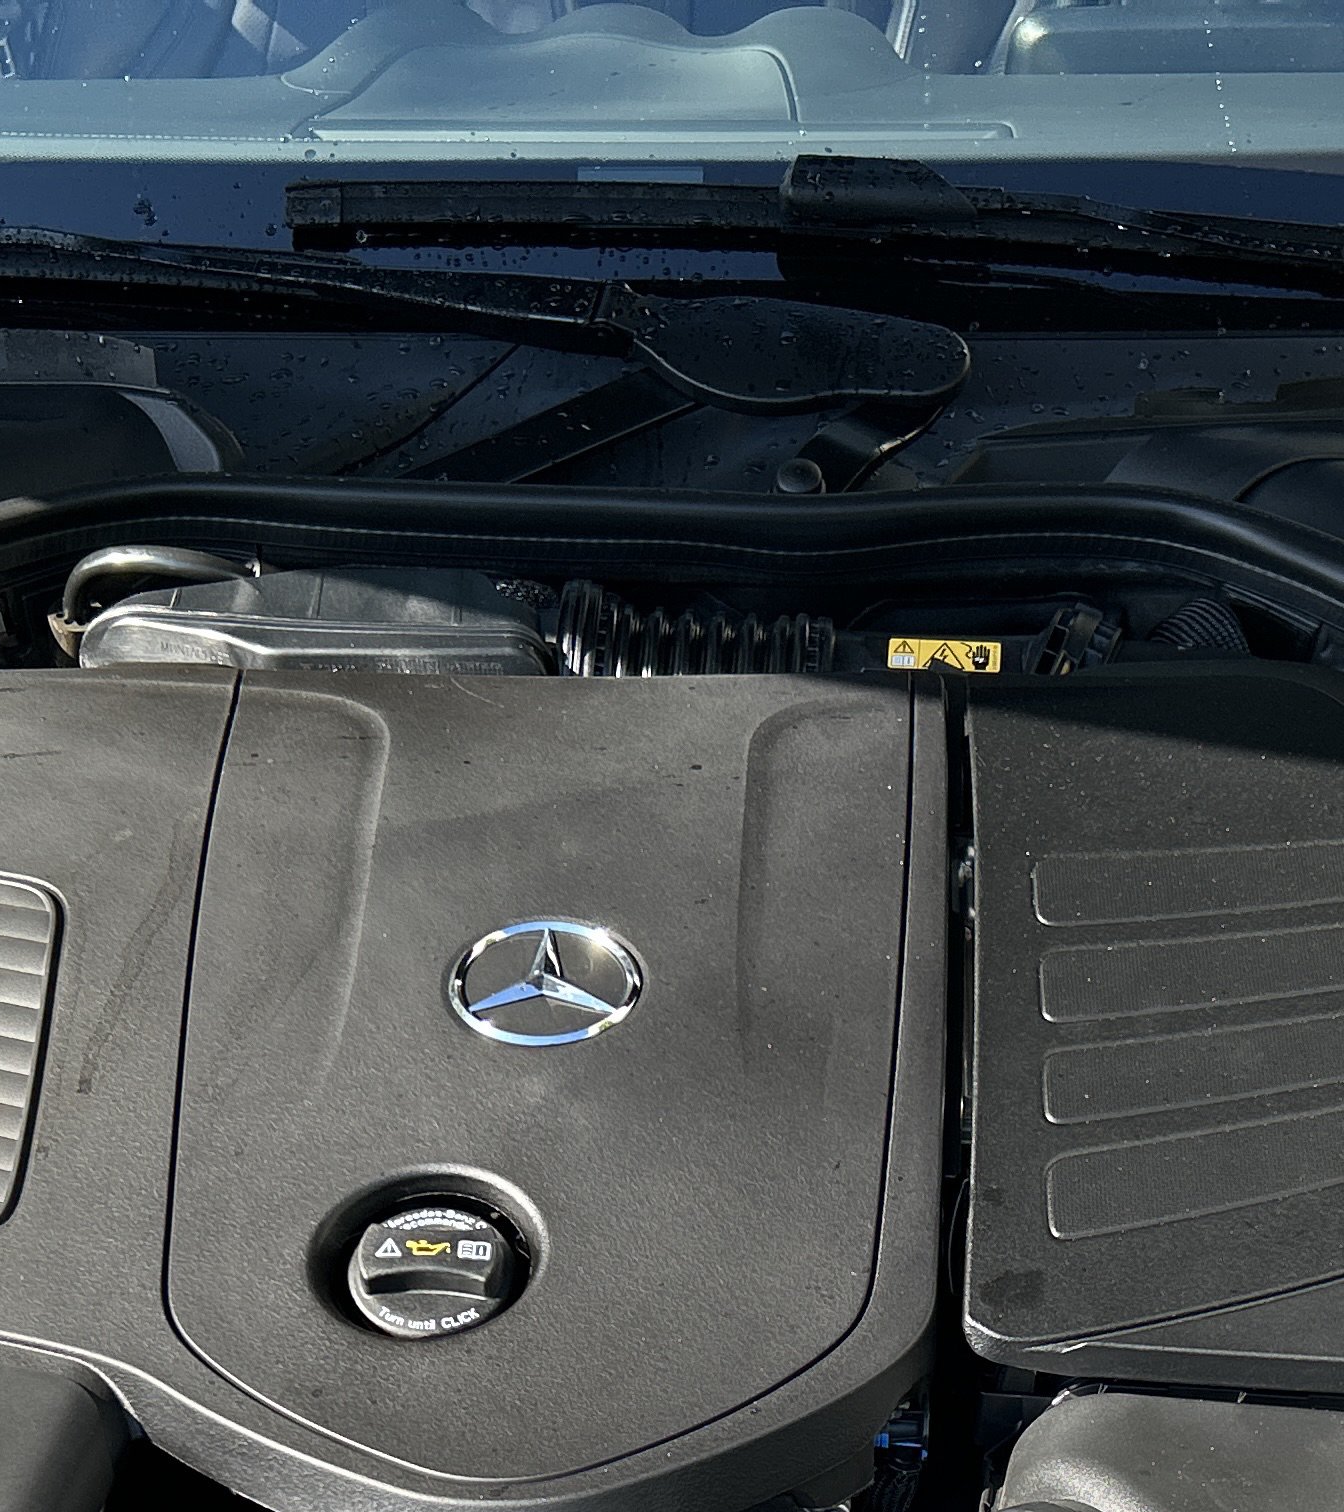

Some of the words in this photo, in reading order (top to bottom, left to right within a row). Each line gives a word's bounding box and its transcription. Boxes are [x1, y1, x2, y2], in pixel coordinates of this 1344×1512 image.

[378, 1306, 405, 1327] Turn
[407, 1318, 437, 1331] until
[440, 1308, 481, 1330] CLICK
